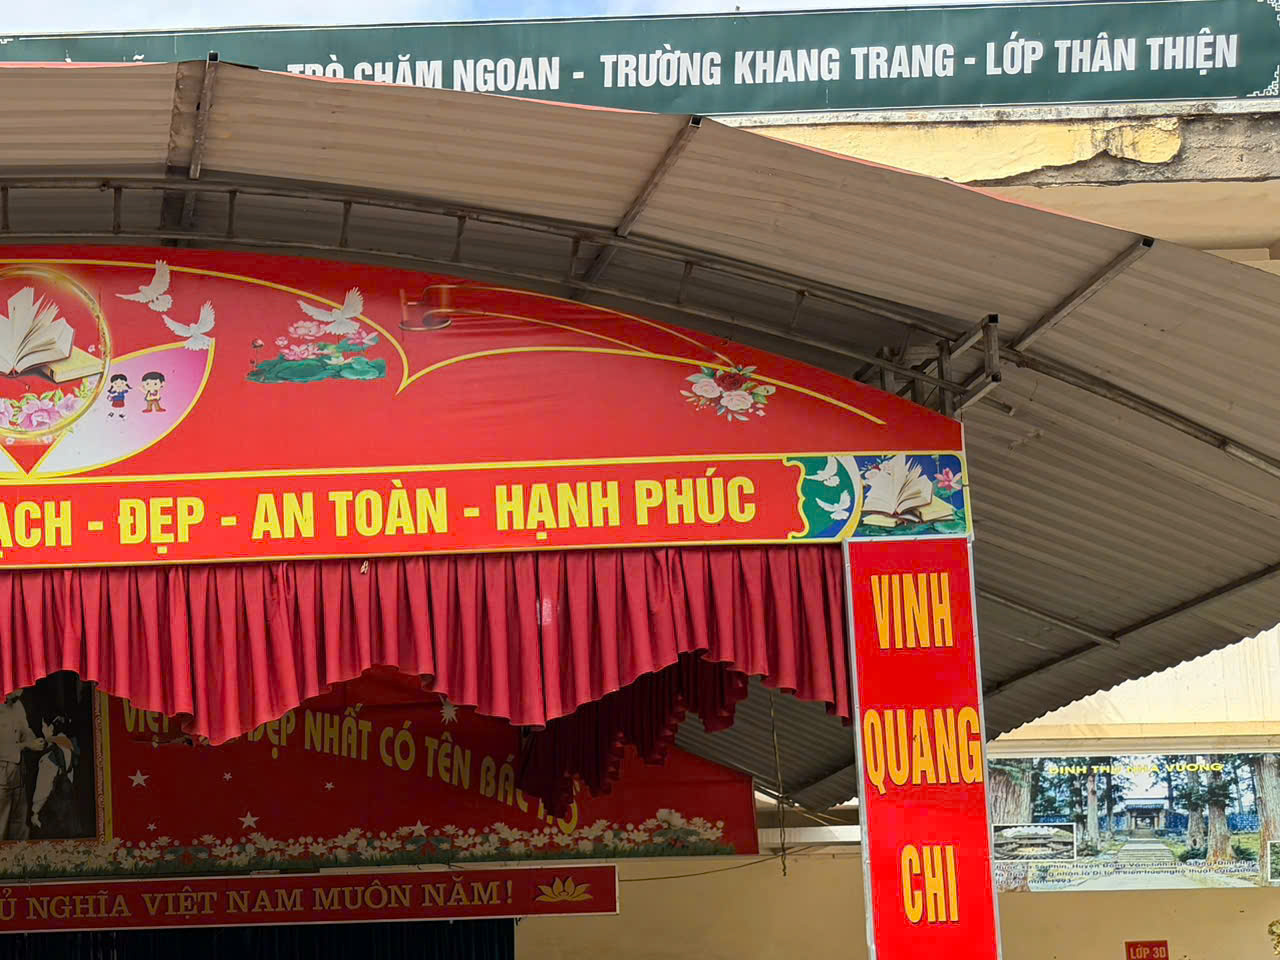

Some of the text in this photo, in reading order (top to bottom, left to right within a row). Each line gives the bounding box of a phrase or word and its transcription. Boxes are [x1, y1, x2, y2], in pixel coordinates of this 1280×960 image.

[453, 57, 560, 92] NGOAN
[600, 44, 721, 88] TRƯỜNG
[734, 47, 839, 84] KHANG
[850, 44, 954, 80] TRANG
[985, 30, 1041, 76] LỚP
[1053, 32, 1135, 73] THÂN
[1145, 27, 1237, 76] THIỆN
[119, 496, 204, 554] ĐẸP
[252, 492, 313, 540] AN
[329, 477, 448, 537] TOÀN
[496, 482, 618, 540] HẠNH
[636, 467, 755, 525] PHÚC
[871, 572, 953, 650] VINH
[379, 720, 416, 771] CÓ
[424, 732, 471, 789] TÊN
[863, 706, 983, 796] QUANG
[25, 889, 131, 919] NGHĨA
[143, 885, 217, 919] VIỆT
[226, 889, 301, 913] NAM
[312, 880, 412, 910] MUÔN
[900, 844, 959, 924] CHI
[1130, 945, 1150, 959] LỚP
